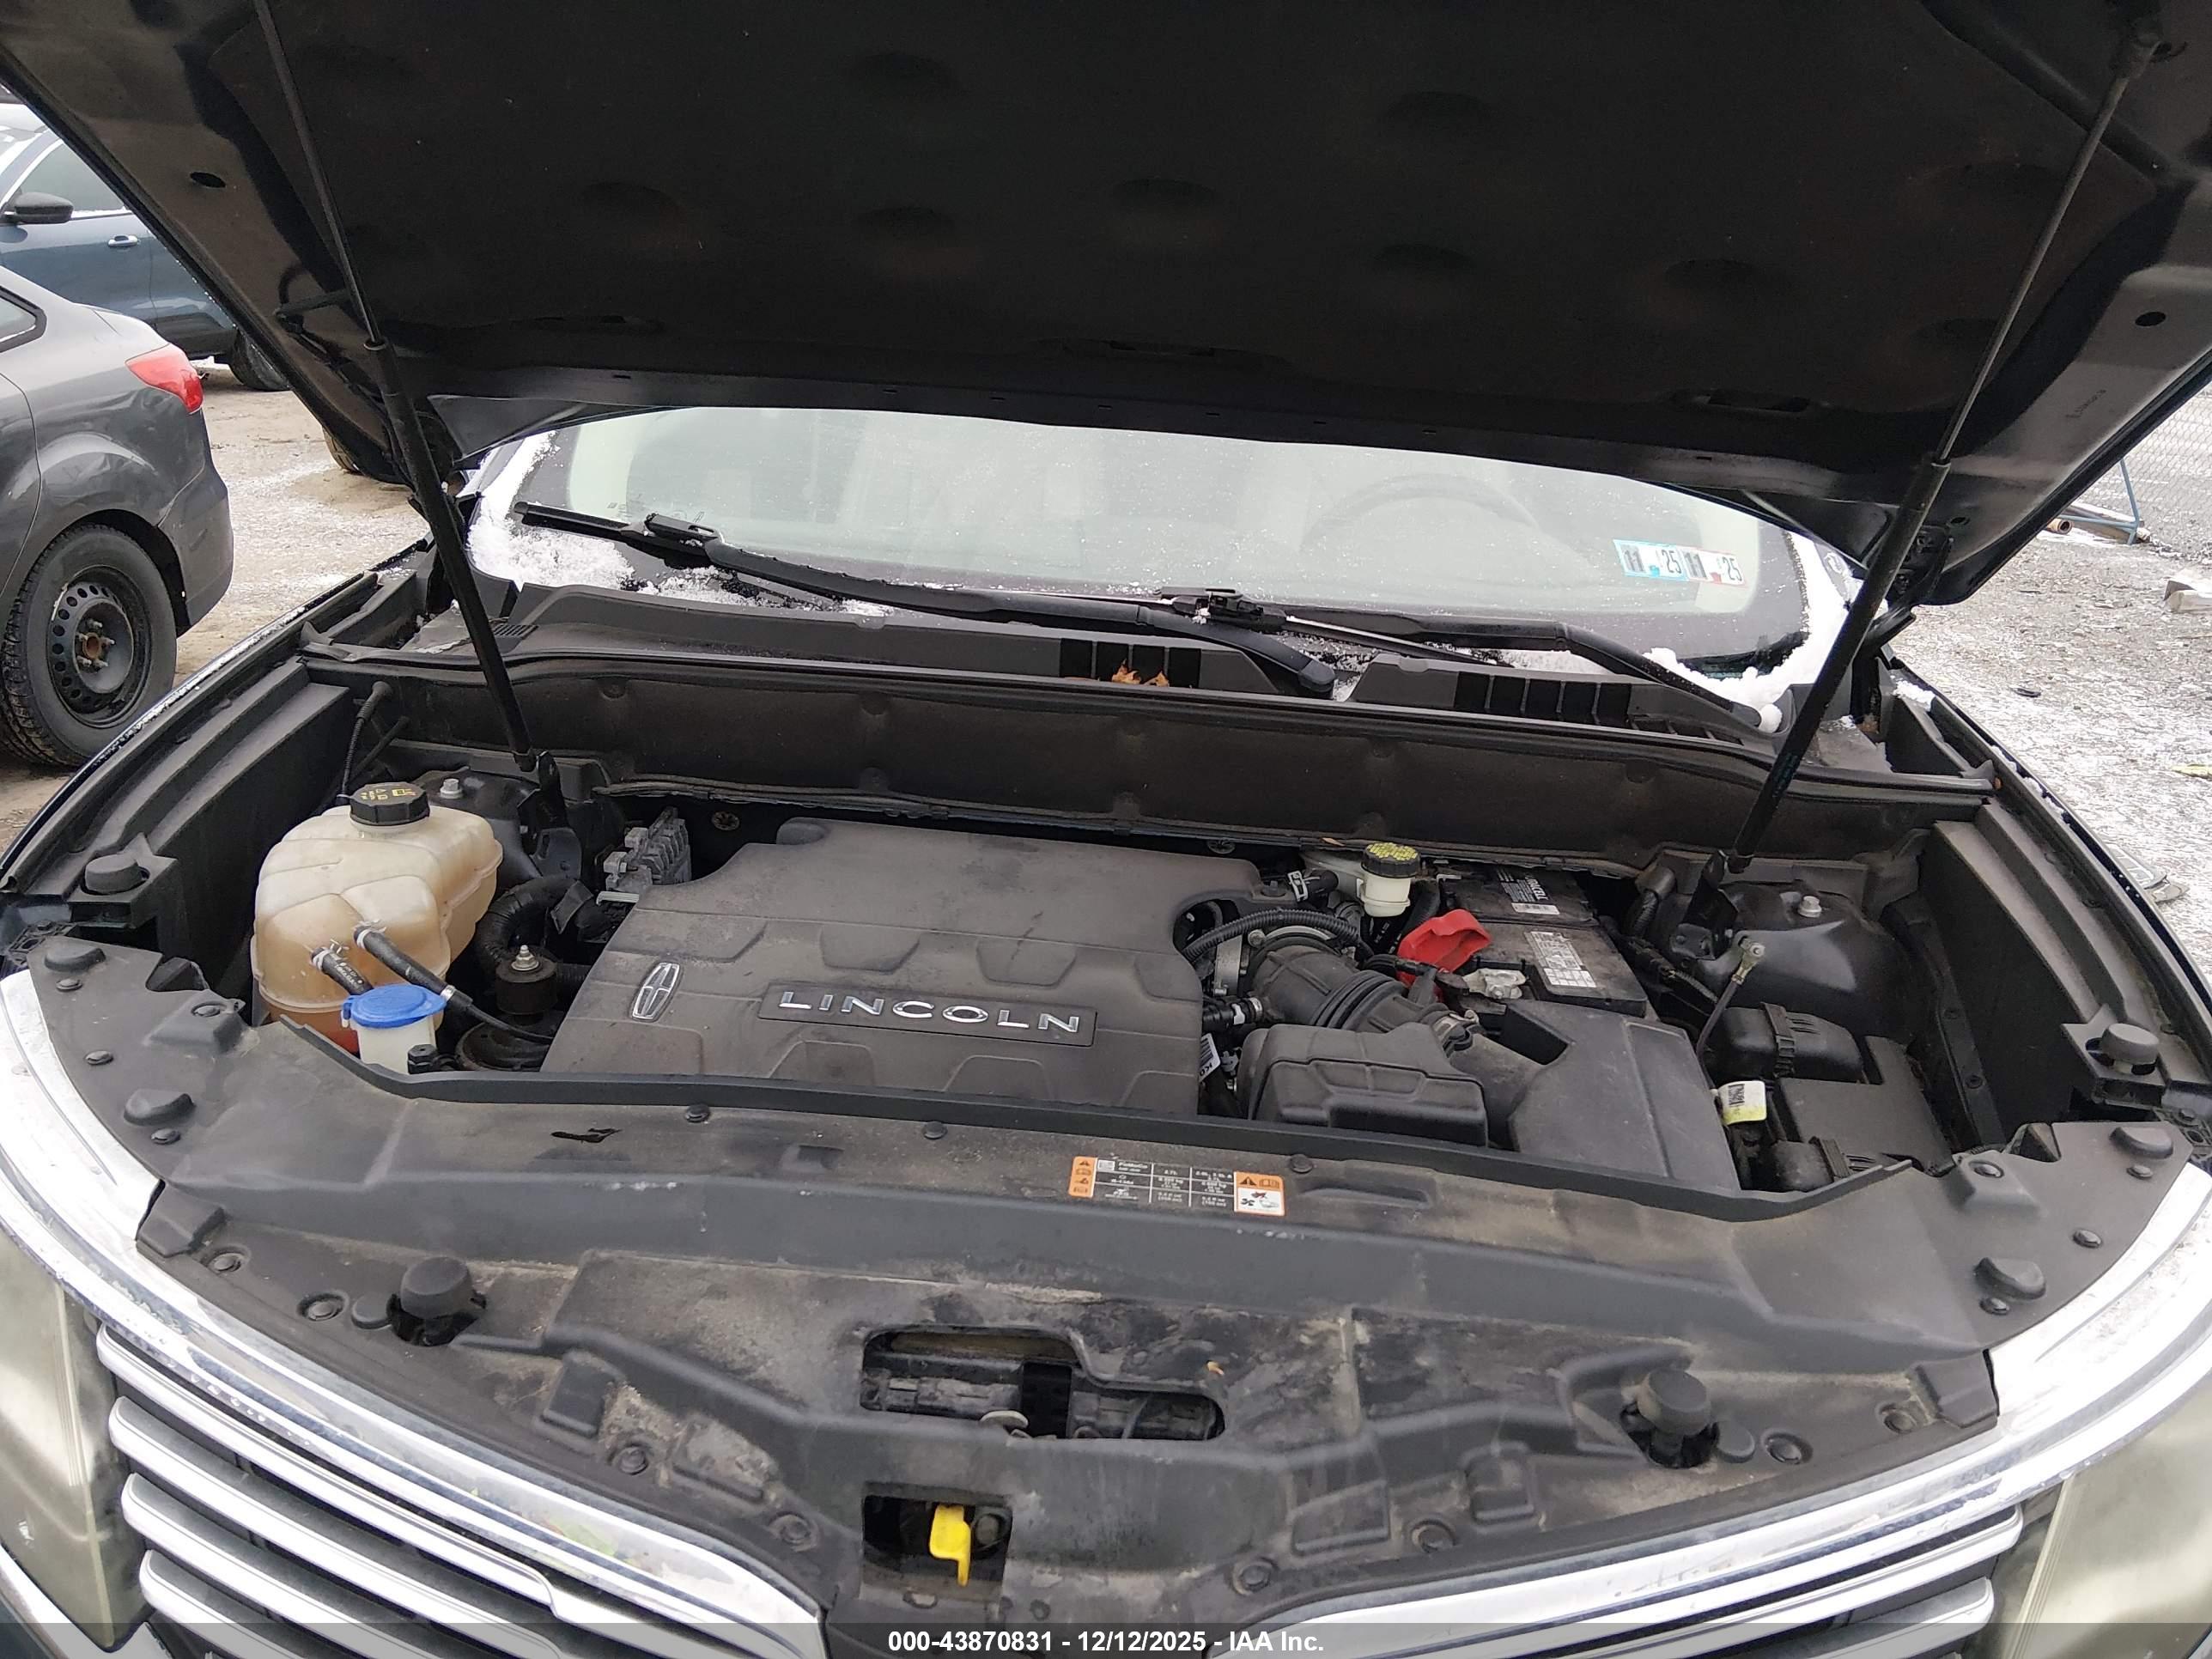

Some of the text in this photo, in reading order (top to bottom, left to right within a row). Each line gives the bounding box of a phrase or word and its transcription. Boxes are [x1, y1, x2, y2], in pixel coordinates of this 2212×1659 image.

[1623, 549, 1682, 574] 11 25
[1684, 552, 1743, 582] 11 25
[779, 991, 1080, 1034] LINCOLN
